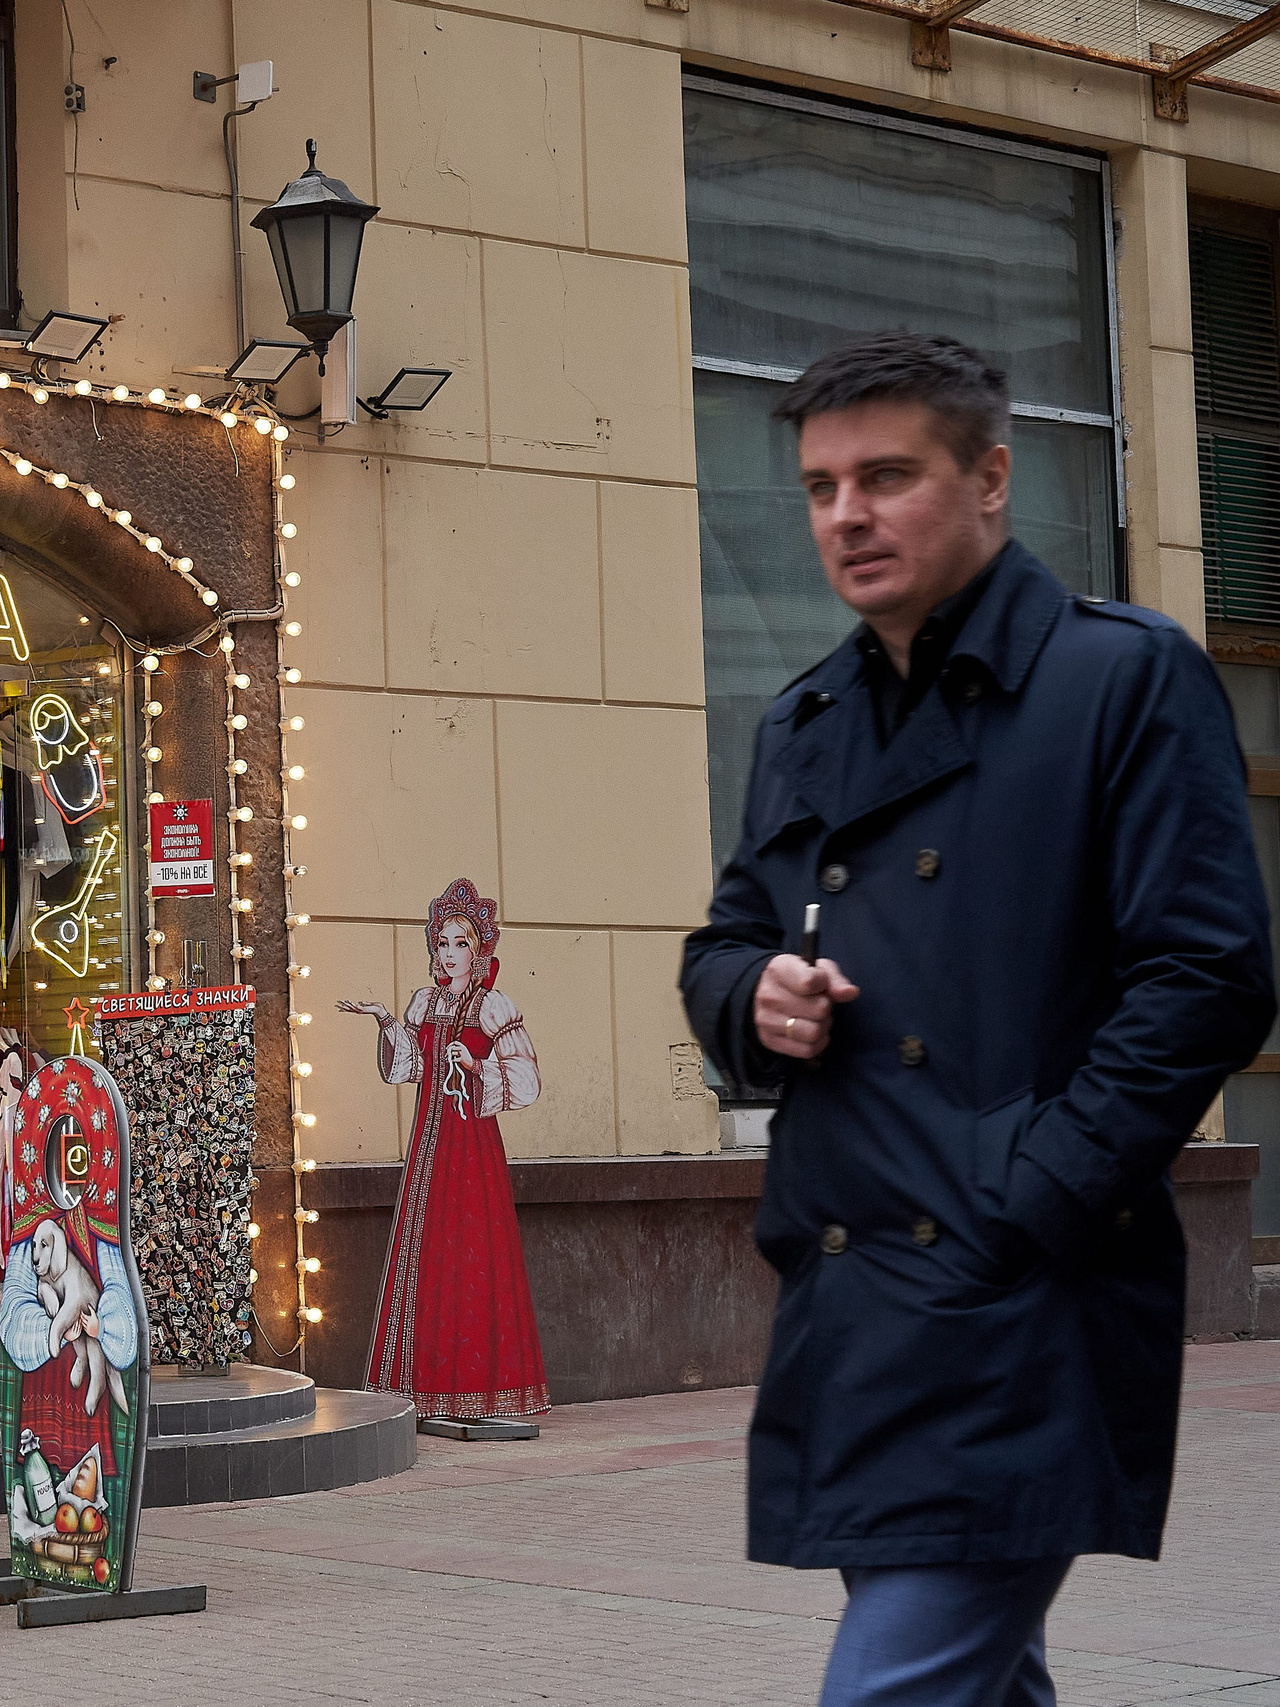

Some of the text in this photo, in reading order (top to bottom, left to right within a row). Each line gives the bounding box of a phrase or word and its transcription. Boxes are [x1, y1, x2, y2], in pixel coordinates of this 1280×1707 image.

[157, 864, 208, 880] -10% НА ВСЁ
[101, 989, 249, 1013] СВЕТЯЩИЕСЯ ЗНАЧКИ
